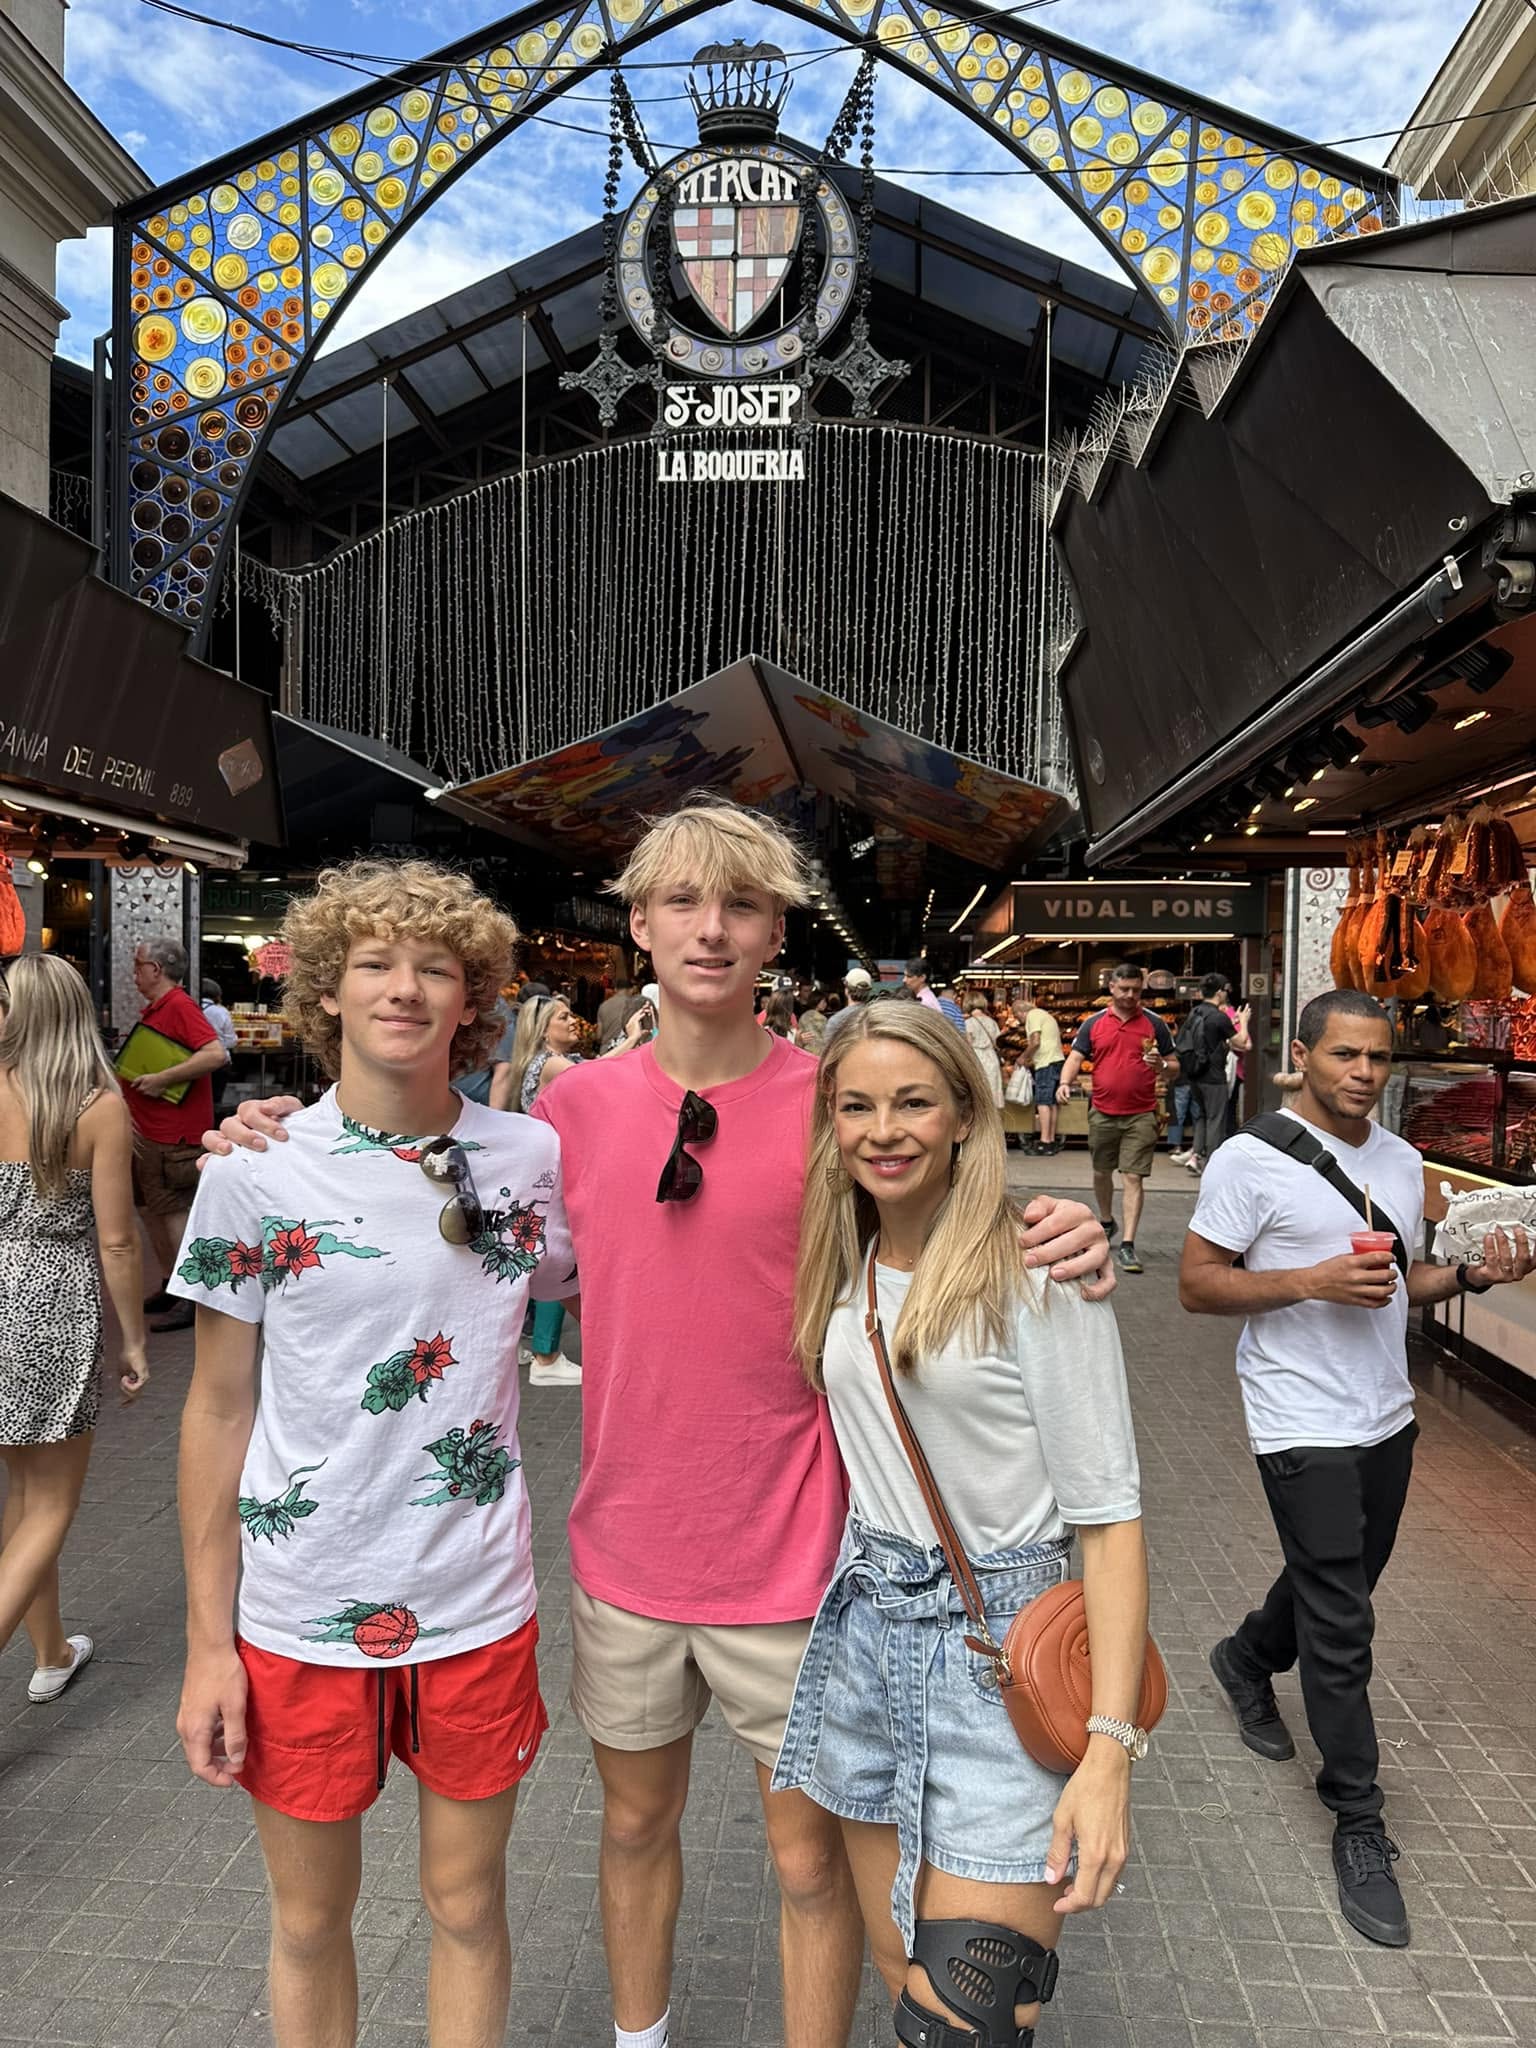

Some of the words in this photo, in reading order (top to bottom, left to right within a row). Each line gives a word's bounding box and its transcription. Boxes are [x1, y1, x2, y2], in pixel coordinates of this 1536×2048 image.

[678, 159, 798, 204] MERCAT
[695, 384, 801, 426] JOSEP
[658, 451, 688, 481] LA
[693, 449, 806, 481] BOQUERIA
[63, 745, 95, 780] DEL
[100, 756, 156, 798] PERNIL
[169, 783, 193, 807] 889
[1044, 899, 1136, 919] VIDAL
[1151, 899, 1234, 919] PONS
